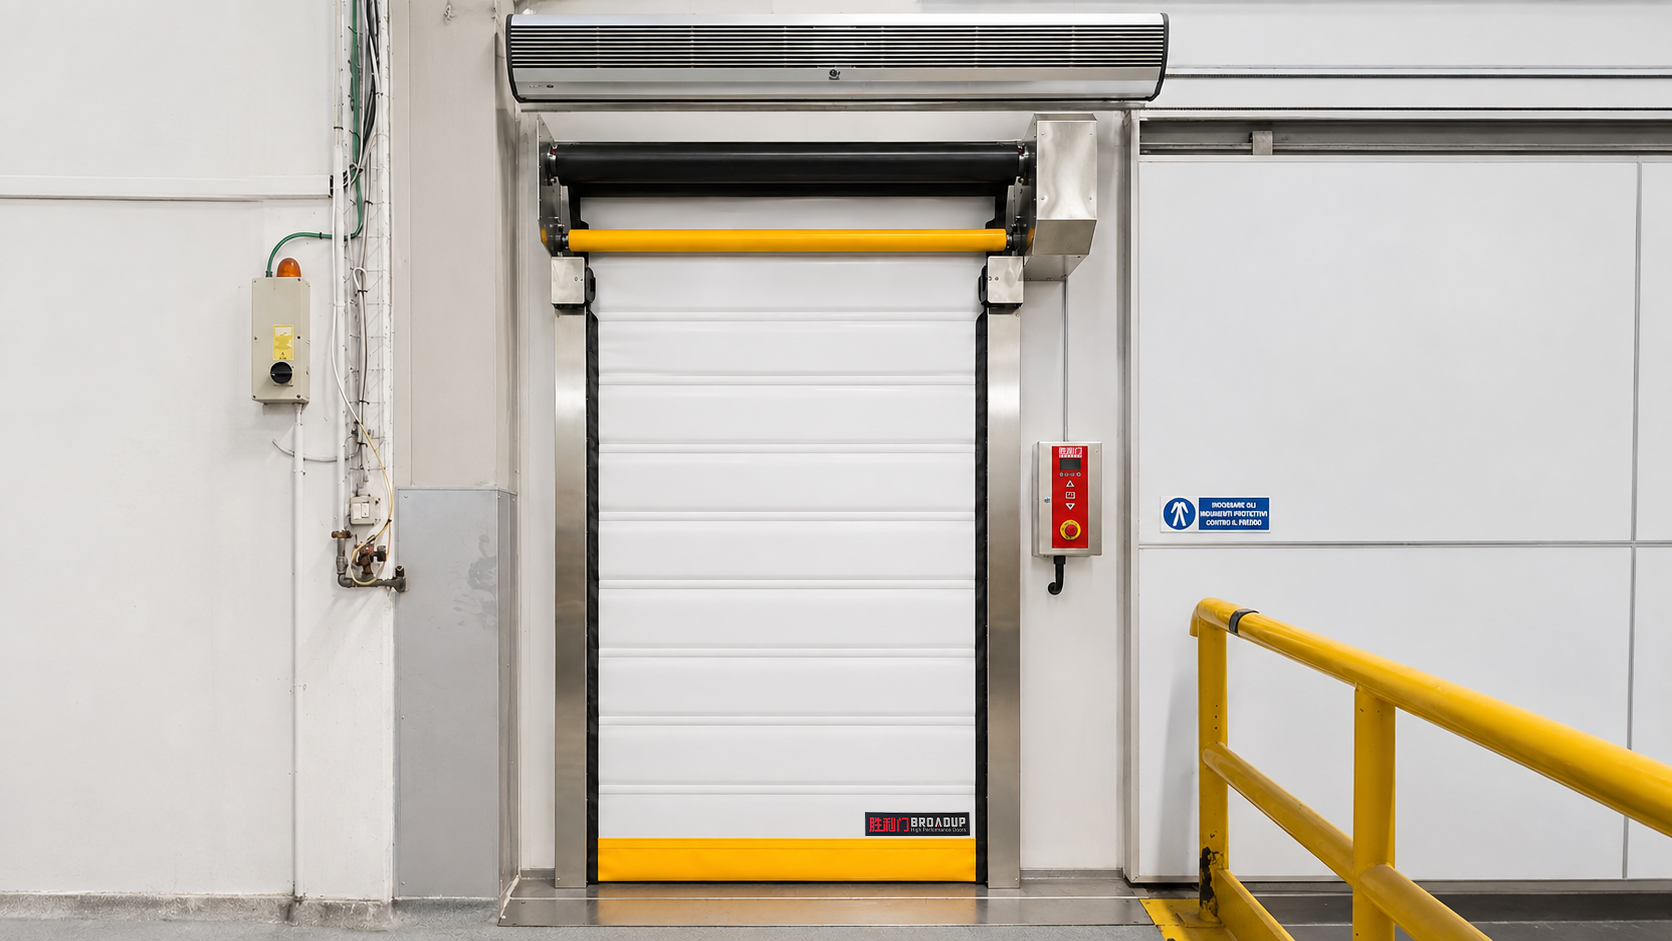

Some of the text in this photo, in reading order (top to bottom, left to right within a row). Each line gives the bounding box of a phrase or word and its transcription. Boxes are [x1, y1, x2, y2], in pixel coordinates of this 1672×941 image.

[869, 817, 909, 832] 胜利门
[911, 817, 966, 827] BROADUP
